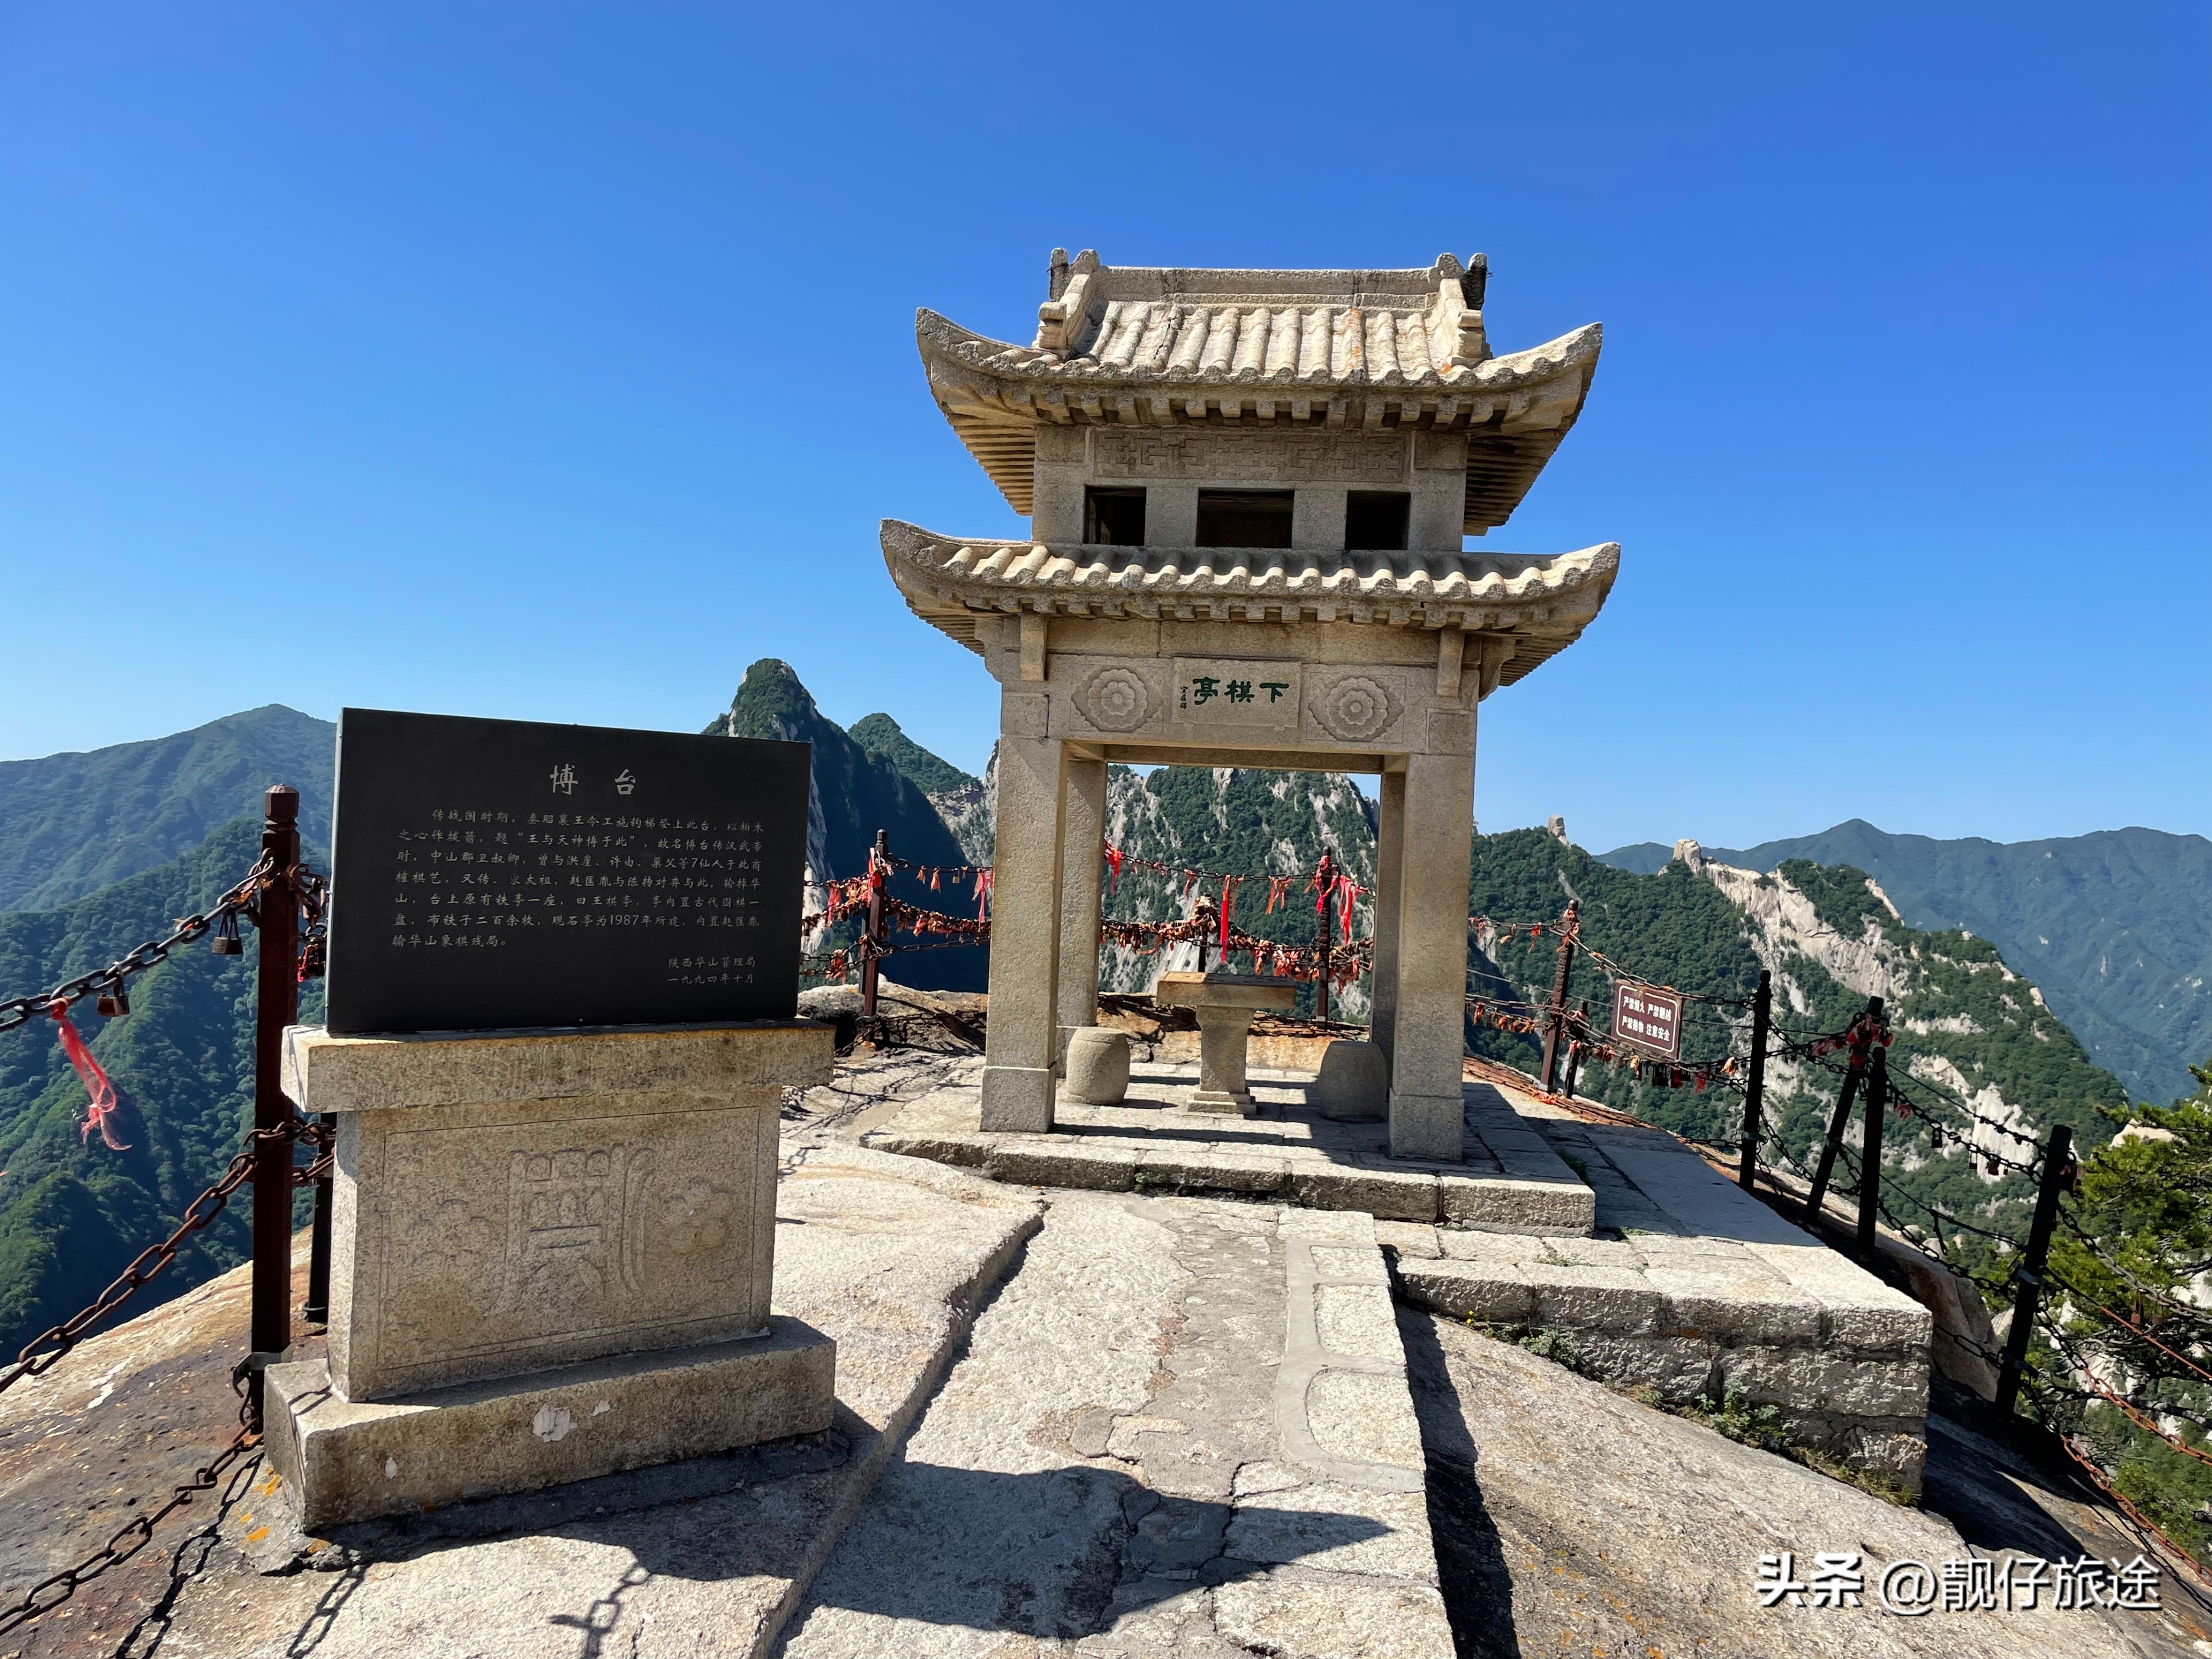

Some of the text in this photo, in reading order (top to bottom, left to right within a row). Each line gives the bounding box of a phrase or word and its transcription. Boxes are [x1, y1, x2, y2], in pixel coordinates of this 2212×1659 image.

[550, 764, 637, 795] 博台
[668, 956, 756, 969] 陕西华山管理局
[667, 973, 754, 985] 一九九四年十月
[1623, 995, 1645, 1013] 严禁烟火
[1646, 1023, 1670, 1041] 注意安全
